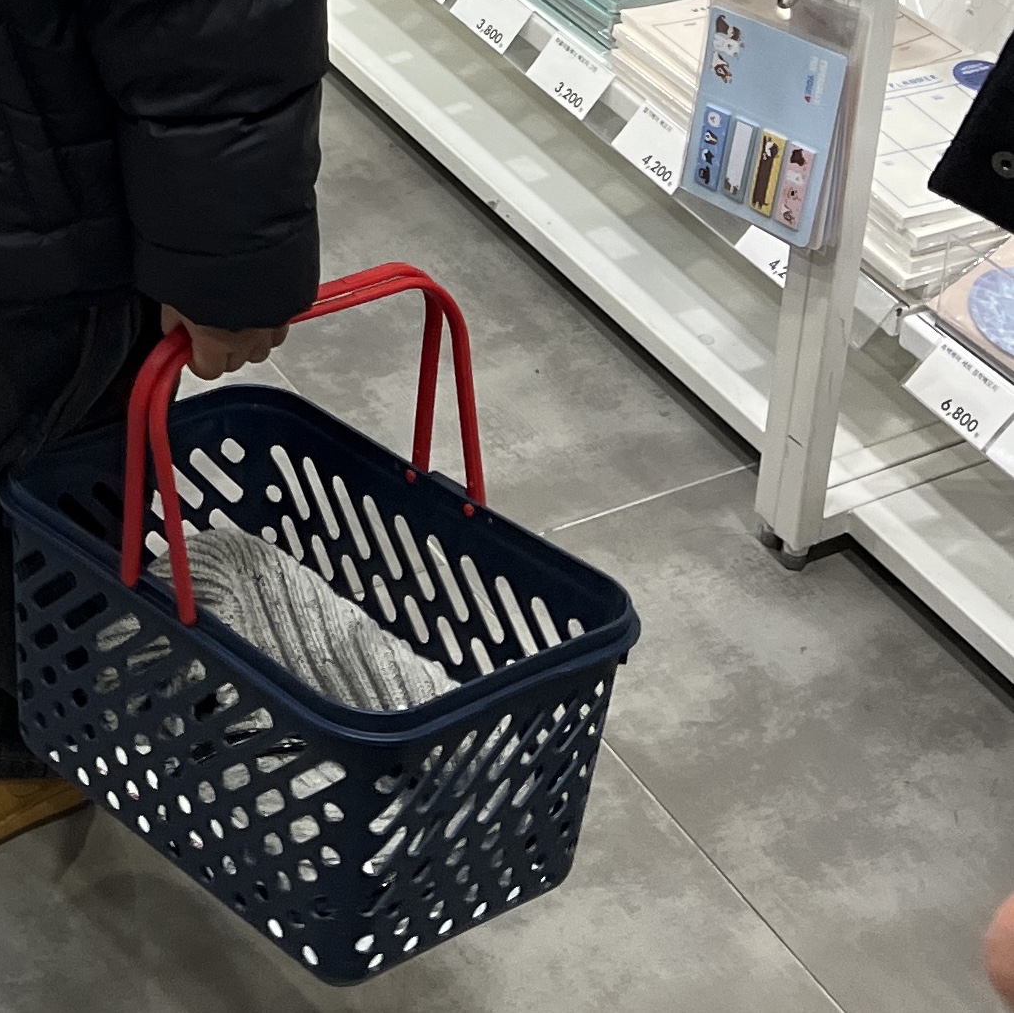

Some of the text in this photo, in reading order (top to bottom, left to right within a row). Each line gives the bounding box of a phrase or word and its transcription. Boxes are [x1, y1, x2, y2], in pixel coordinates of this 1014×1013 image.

[476, 18, 504, 45] 3,800
[554, 81, 584, 109] 3,200
[642, 154, 673, 183] 4,200
[940, 398, 979, 433] 6,800
